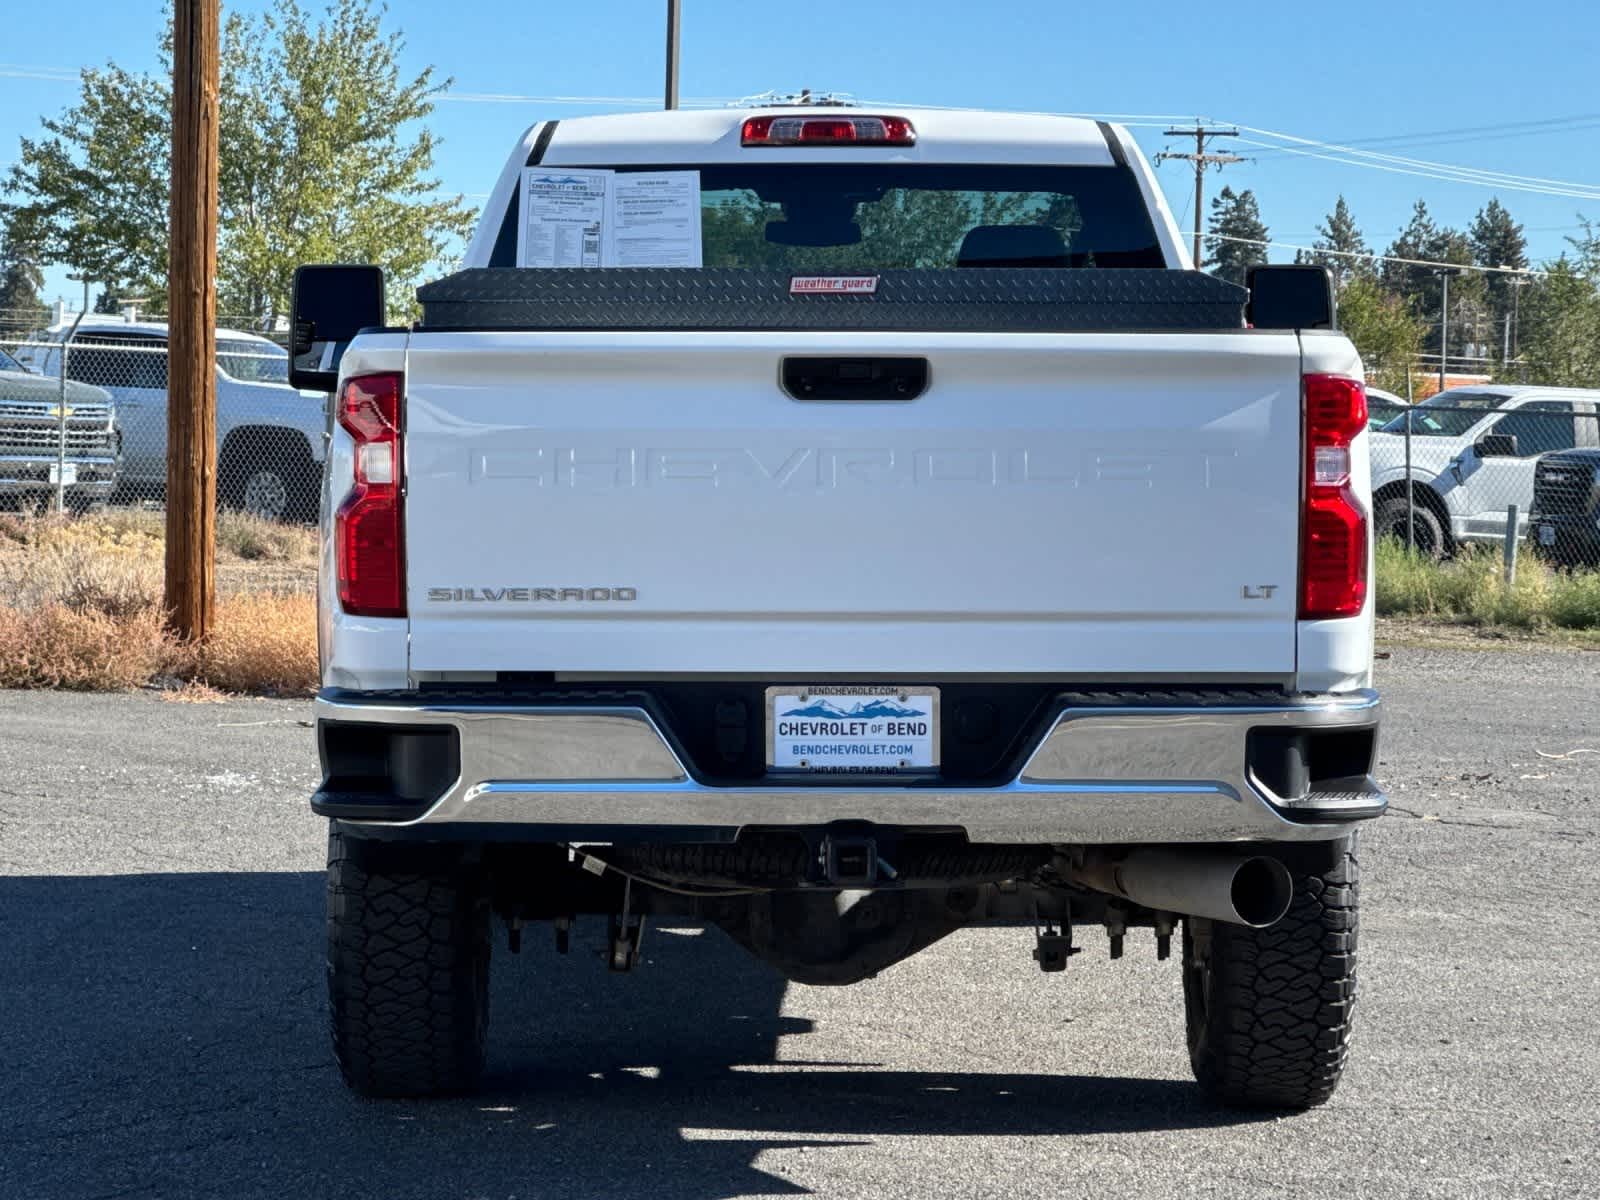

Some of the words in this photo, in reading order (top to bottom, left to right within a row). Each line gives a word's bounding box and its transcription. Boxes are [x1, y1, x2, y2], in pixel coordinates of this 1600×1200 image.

[794, 277, 839, 289] weather
[841, 278, 873, 289] guard
[466, 446, 1239, 490] CHEVROLET
[428, 587, 637, 601] SILVERADO
[1240, 584, 1279, 600] LT
[808, 687, 899, 696] BENDCHEVROLET.COM
[779, 722, 868, 736] CHEVROLET
[871, 724, 883, 734] OF
[887, 722, 927, 736] BEND
[792, 744, 913, 755] BENDCHEVROLET.COM
